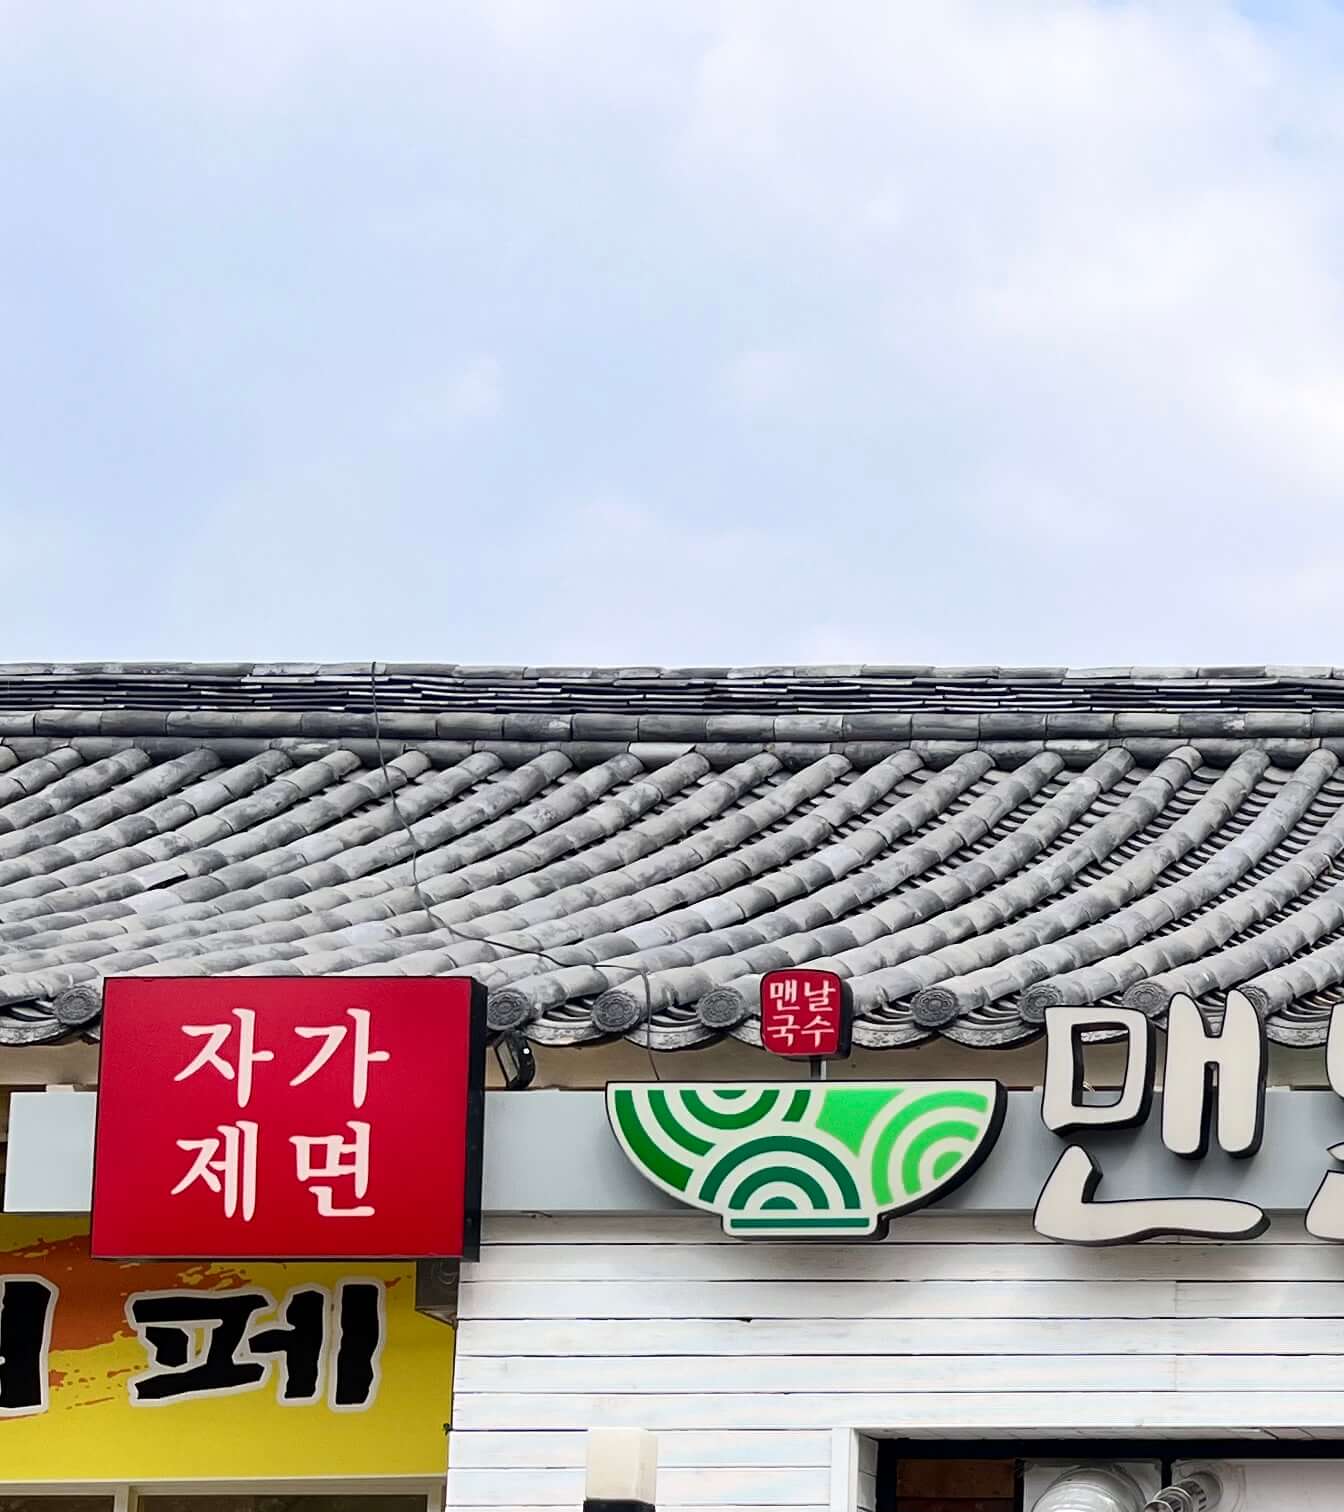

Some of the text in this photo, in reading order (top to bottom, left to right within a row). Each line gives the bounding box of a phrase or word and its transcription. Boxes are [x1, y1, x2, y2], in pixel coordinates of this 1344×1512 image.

[767, 979, 836, 1012] 맨날
[174, 1007, 390, 1109] 자가
[767, 1014, 835, 1048] 국수
[171, 1120, 375, 1221] 제면
